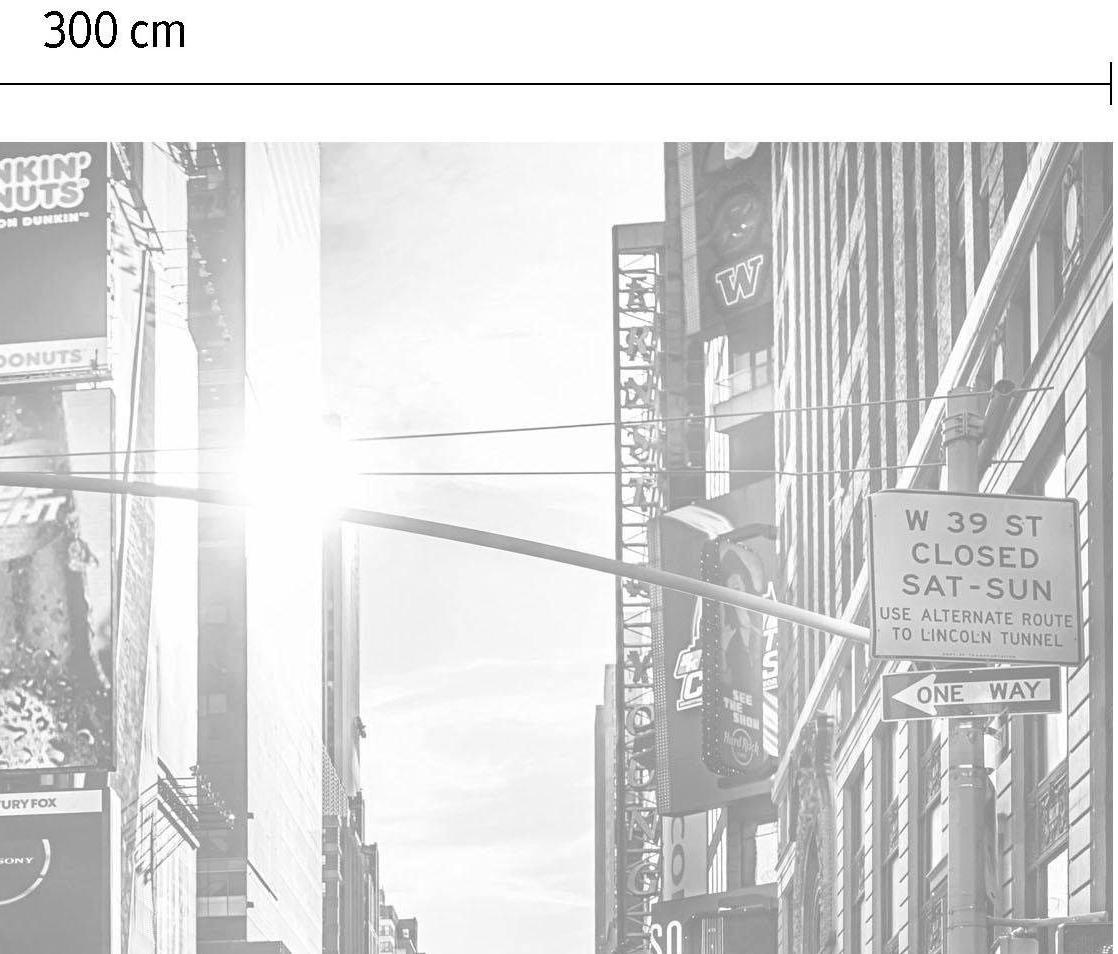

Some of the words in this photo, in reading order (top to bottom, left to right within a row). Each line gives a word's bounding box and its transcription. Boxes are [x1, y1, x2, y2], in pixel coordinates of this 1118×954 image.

[715, 254, 764, 306] W
[905, 509, 929, 532] W
[946, 511, 988, 534] 39
[1005, 514, 1043, 537] ST
[911, 542, 1039, 569] CLOSED
[902, 573, 1052, 602] SAT-SUN
[879, 606, 911, 621] USE
[921, 608, 1014, 626] ALTERNATE
[1022, 612, 1073, 628] ROUTE
[892, 626, 912, 641] TO
[921, 629, 992, 644] LINCOLN
[1000, 631, 1064, 648] TUNNEL
[917, 684, 964, 705] ONE
[990, 680, 1042, 701] WAY
[31, 798, 57, 809] FOX
